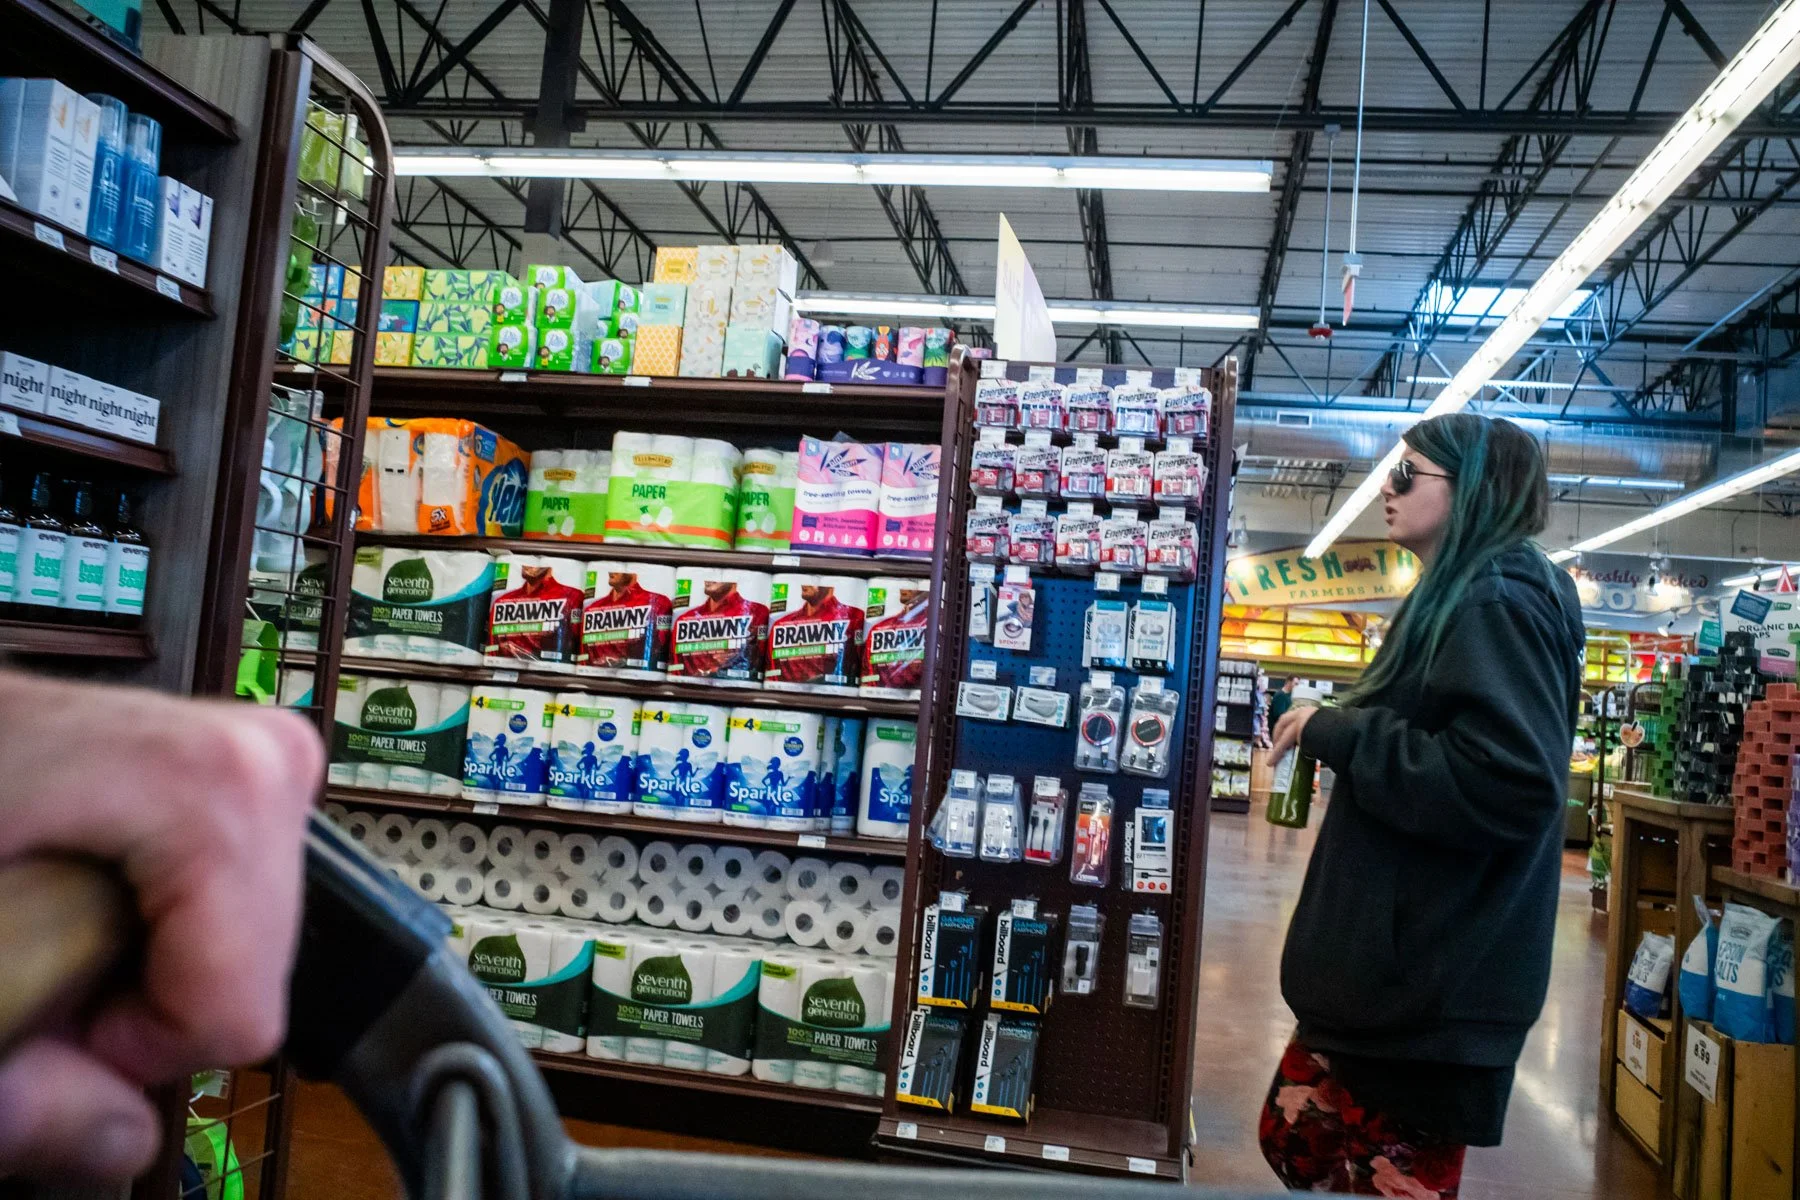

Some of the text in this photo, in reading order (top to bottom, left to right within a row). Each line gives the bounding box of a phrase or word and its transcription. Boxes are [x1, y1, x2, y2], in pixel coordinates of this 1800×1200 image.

[3, 371, 44, 394] night
[51, 384, 87, 406] night
[980, 386, 1018, 398] Energizer
[1023, 389, 1062, 400] Energizer
[1070, 391, 1109, 402] Energizer
[1118, 392, 1157, 403] Energizer
[1165, 392, 1205, 407] Energizer
[89, 395, 122, 417] night
[123, 407, 156, 428] night
[976, 450, 1015, 460] Energizer
[1019, 452, 1059, 463] Energizer
[1065, 453, 1104, 466] Energizer
[1110, 455, 1151, 468] Energizer
[1158, 457, 1199, 468] Energizer
[632, 484, 666, 499] PAPER
[541, 496, 570, 511] PAPER
[970, 515, 1009, 528] Energizer
[1014, 521, 1053, 532] Energizer
[1060, 520, 1100, 533] Energizer
[1105, 526, 1145, 538] Energizer
[1152, 527, 1192, 539] Energizer
[387, 576, 429, 590] seventh
[387, 586, 429, 597] generation
[1290, 587, 1365, 599] FARMERS
[392, 607, 412, 620] PAPER
[415, 609, 443, 623] TOWELS
[494, 601, 564, 621] BRAWNY
[584, 608, 649, 631] BRAWNY
[678, 618, 750, 640] BRAWNY
[774, 622, 847, 645] BRAWNY
[1738, 623, 1785, 632] ORGANIC
[476, 696, 484, 708] 4
[367, 703, 413, 718] seventh
[561, 704, 570, 716] 4
[654, 711, 664, 723] 4
[366, 714, 412, 725] generation
[744, 718, 754, 731] 4
[371, 735, 394, 749] PAPER
[397, 739, 427, 752] TOWELS
[463, 758, 516, 780] Sparkle
[549, 766, 606, 789] Sparkle
[640, 773, 700, 796] Sparkle
[729, 782, 793, 805] Sparkle
[1125, 822, 1134, 863] billboard
[924, 915, 936, 960] billboard
[997, 920, 1009, 964] billboard
[474, 952, 522, 968] seventh
[472, 964, 521, 977] generation
[638, 974, 687, 990] seventh
[506, 990, 537, 1006] TOWELS
[636, 984, 686, 998] generation
[809, 996, 860, 1014] seventh
[618, 1004, 704, 1028] 100% PAPER TOWELS
[807, 1008, 859, 1021] generation
[787, 1027, 877, 1052] 100% PAPER TOWELS
[907, 1014, 922, 1057] billboard
[1694, 1043, 1710, 1065] 8.99
